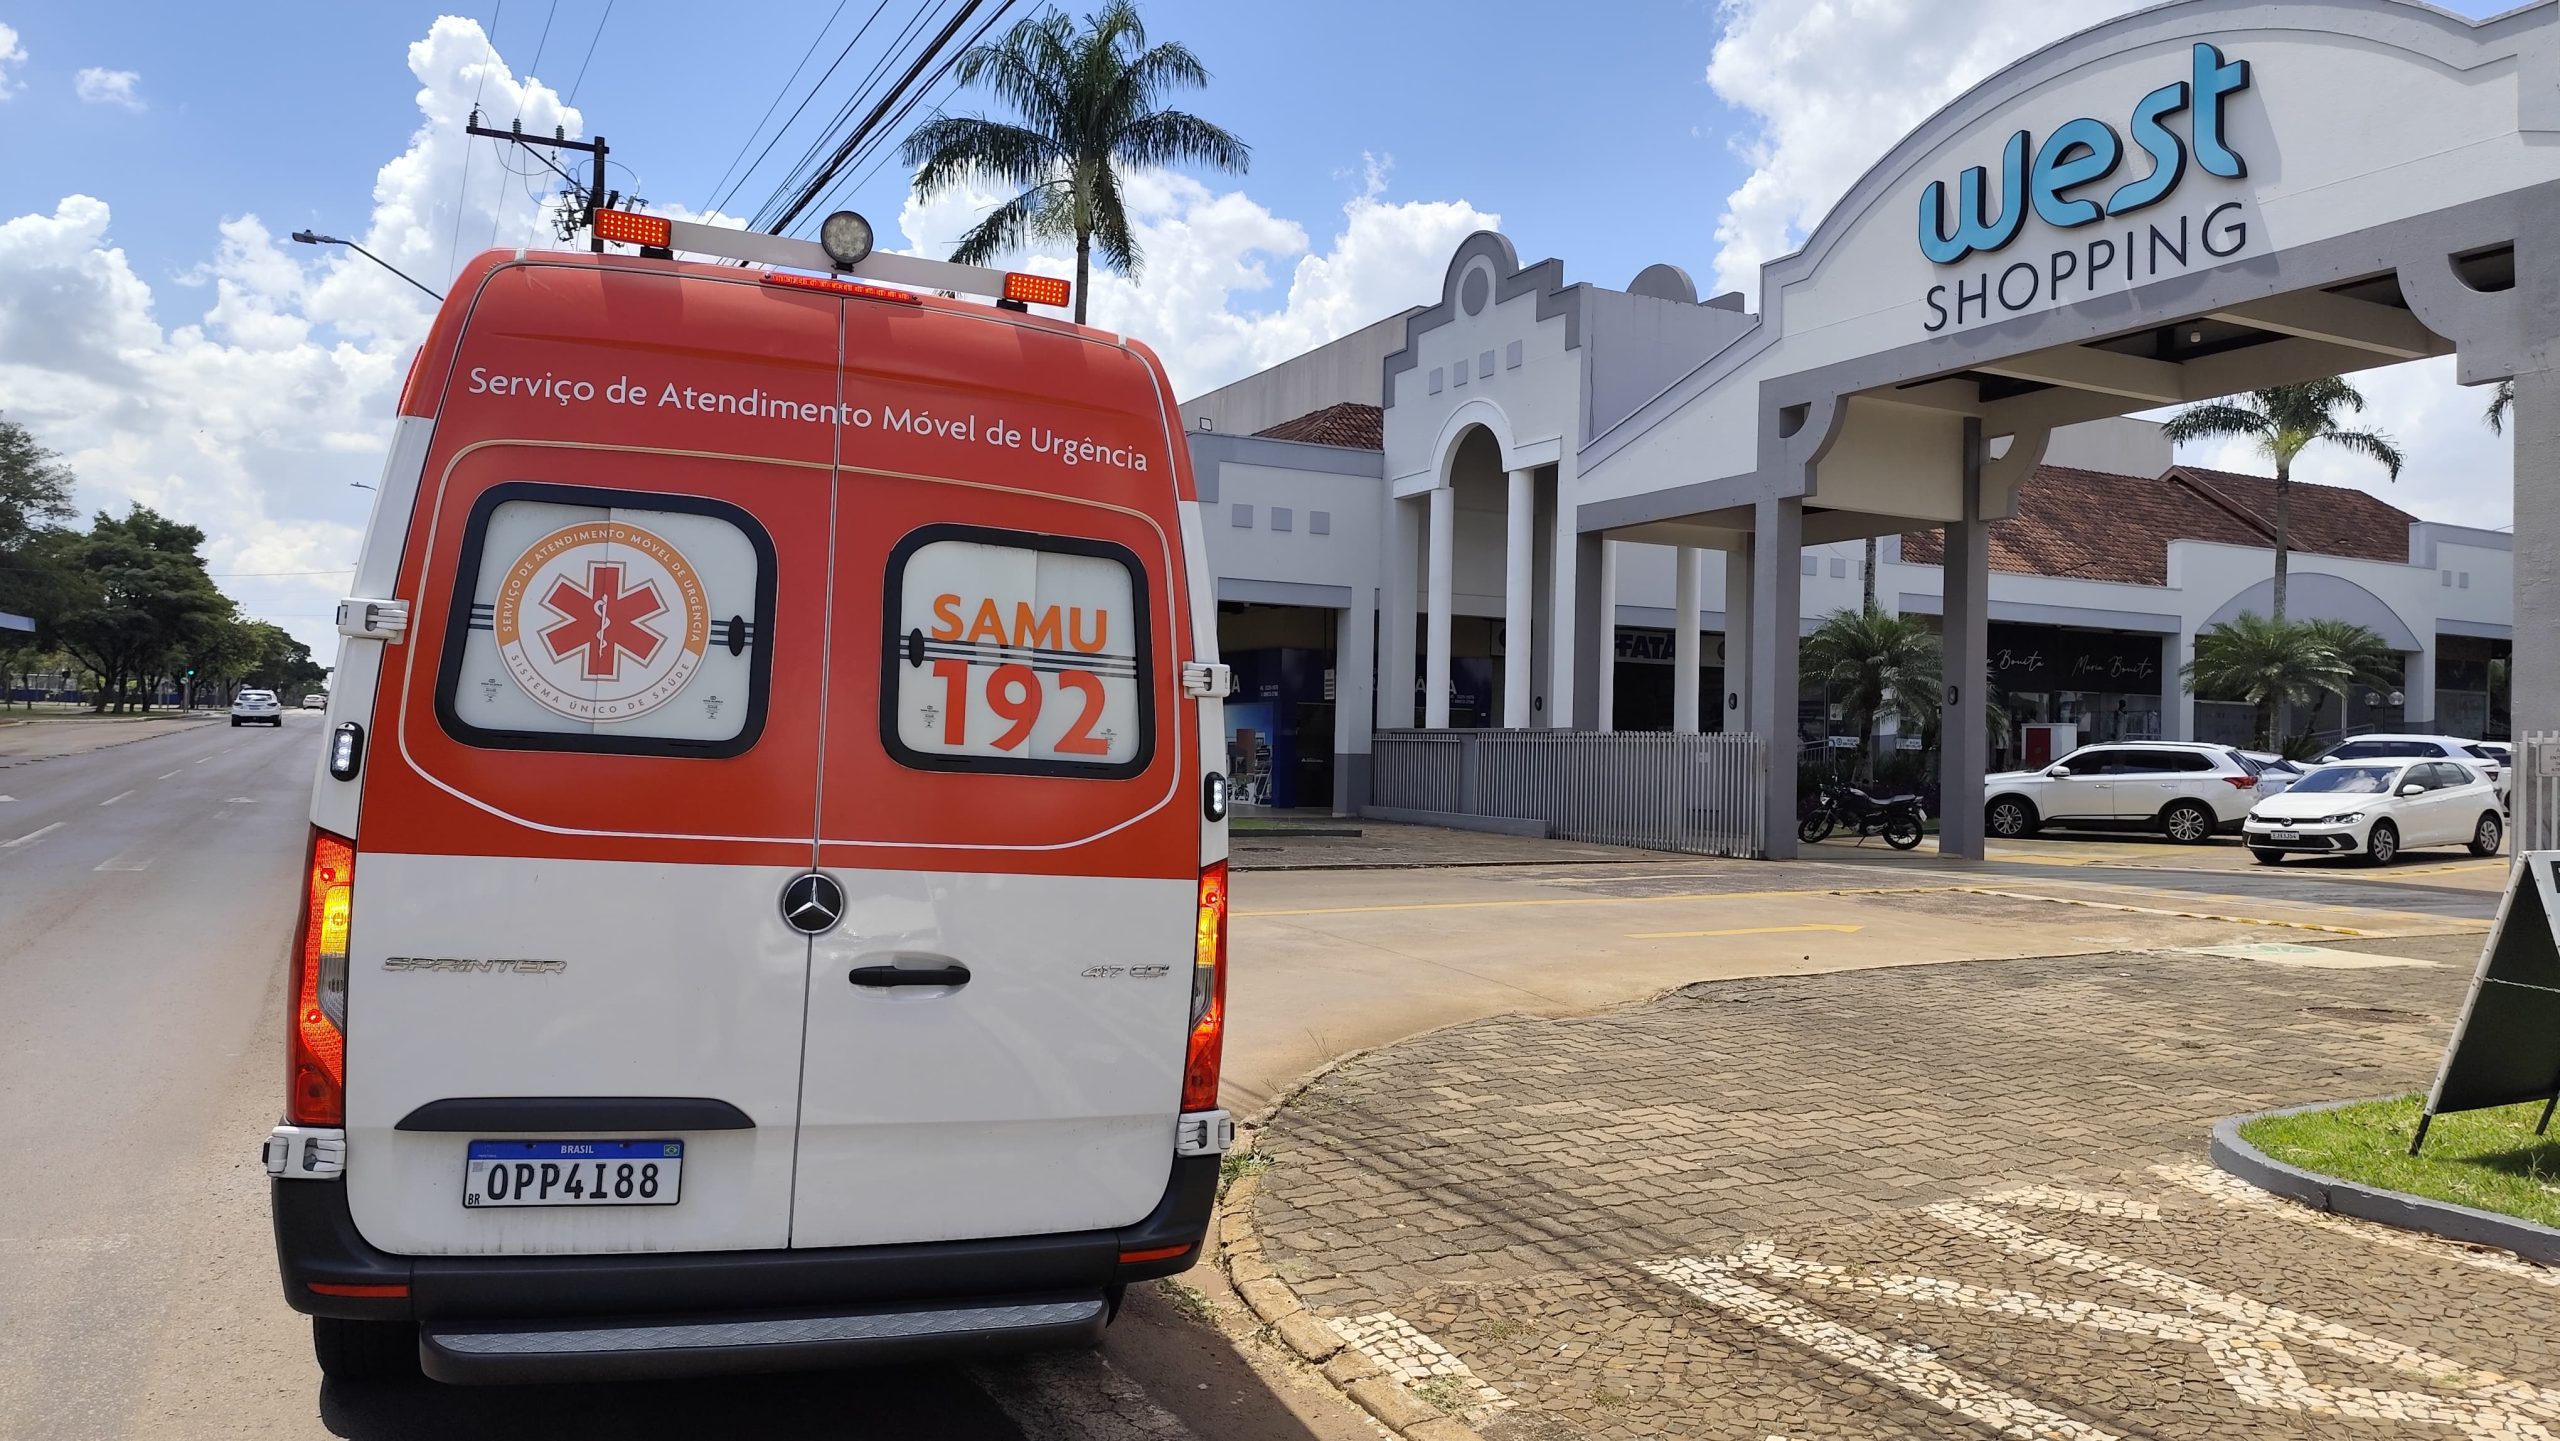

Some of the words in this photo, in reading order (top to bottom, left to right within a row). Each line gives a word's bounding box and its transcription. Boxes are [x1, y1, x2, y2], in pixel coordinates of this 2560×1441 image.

[1919, 43, 2250, 265] west
[1924, 202, 2247, 332] SHOPPING
[468, 367, 595, 406] Serviço
[605, 376, 648, 406] de
[657, 382, 872, 428] Atendimento
[882, 406, 976, 442] Móvel
[985, 419, 1022, 449] de
[1030, 427, 1148, 472] Urgência
[503, 581, 521, 632] SERVIÇO
[519, 561, 534, 577] DE
[534, 529, 625, 562] ATENDIMENTO
[630, 534, 671, 562] MÓVEL
[671, 562, 686, 578] DE
[683, 580, 702, 642] URGÊNCIA
[931, 593, 1107, 653] SAMU
[511, 655, 559, 703] SISTEMA
[569, 701, 617, 714] ÚNICO
[628, 698, 645, 710] DE
[652, 663, 689, 699] SAÚDE
[933, 659, 1108, 756] 192
[382, 957, 567, 975] SPRINTER
[560, 1145, 594, 1154] BRASIL
[468, 1193, 480, 1205] BR
[487, 1163, 659, 1200] OPP4I88
